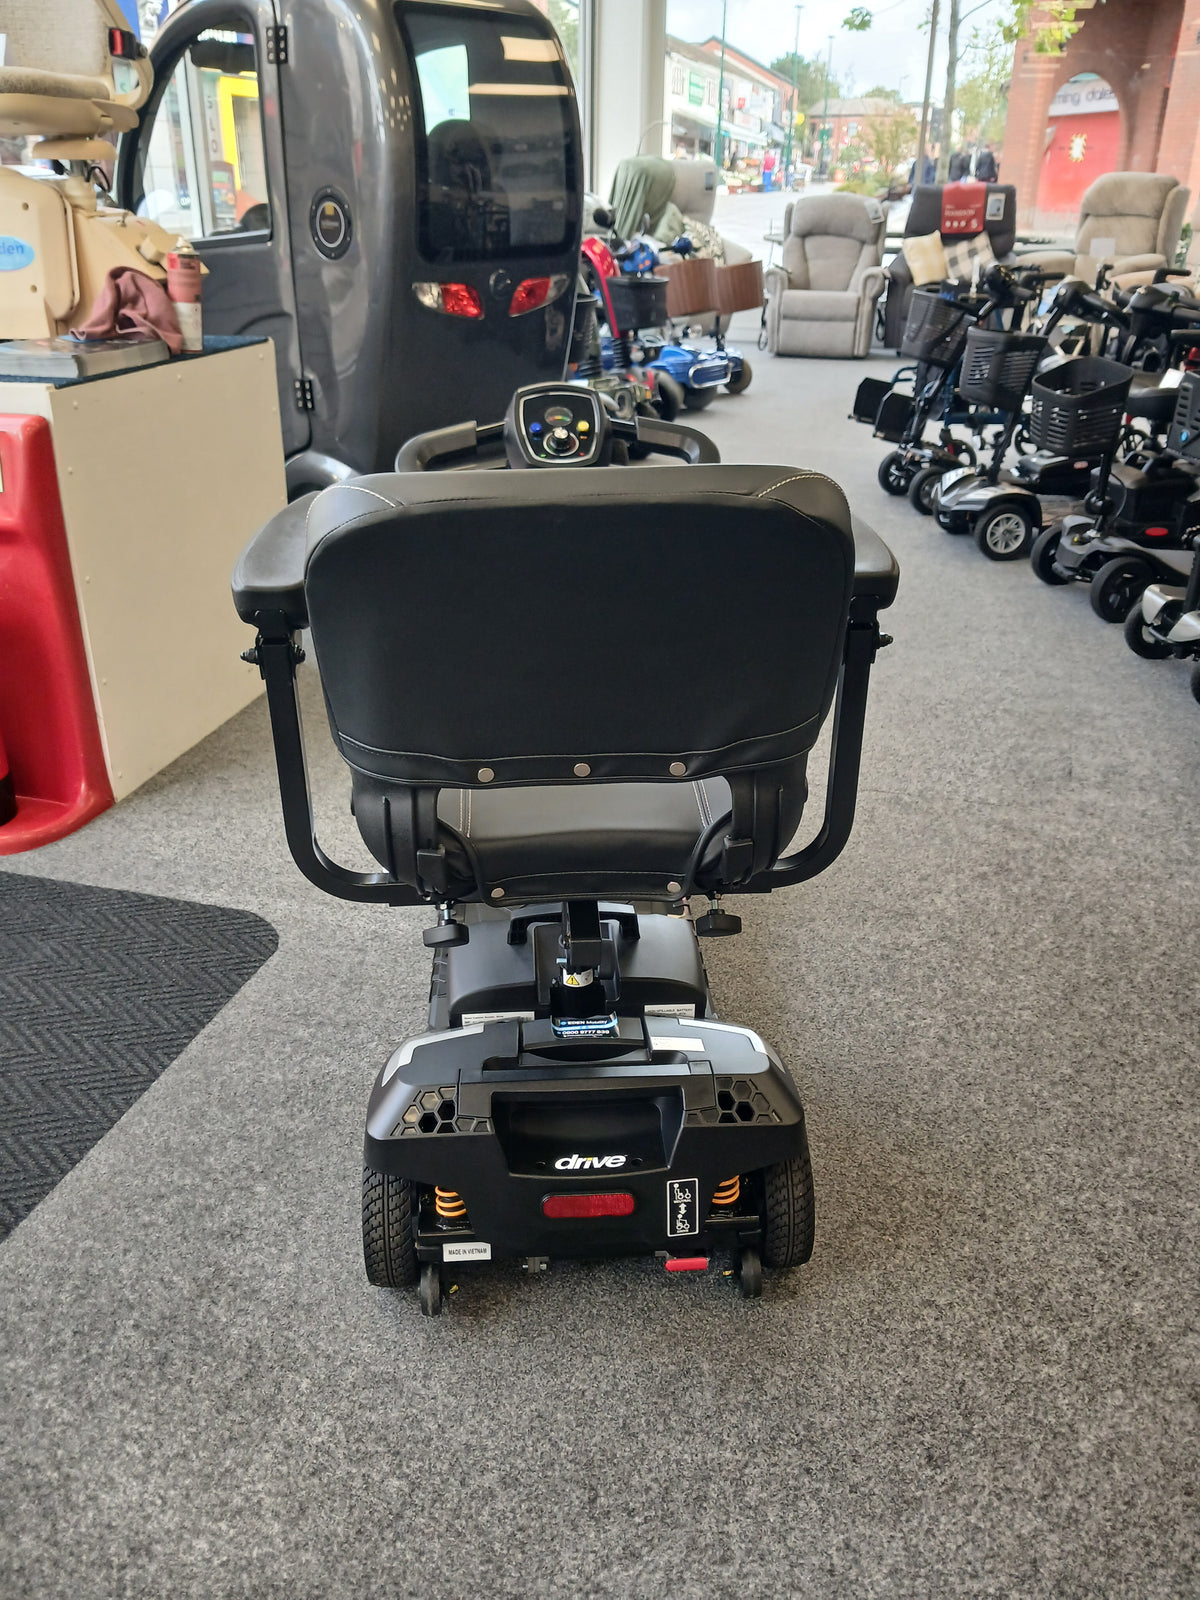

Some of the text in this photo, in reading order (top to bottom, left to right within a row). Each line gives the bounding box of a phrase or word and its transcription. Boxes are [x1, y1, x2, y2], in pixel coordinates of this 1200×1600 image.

[554, 1154, 627, 1170] drive
[448, 1248, 462, 1256] MADE
[468, 1247, 488, 1255] VIETNAM
